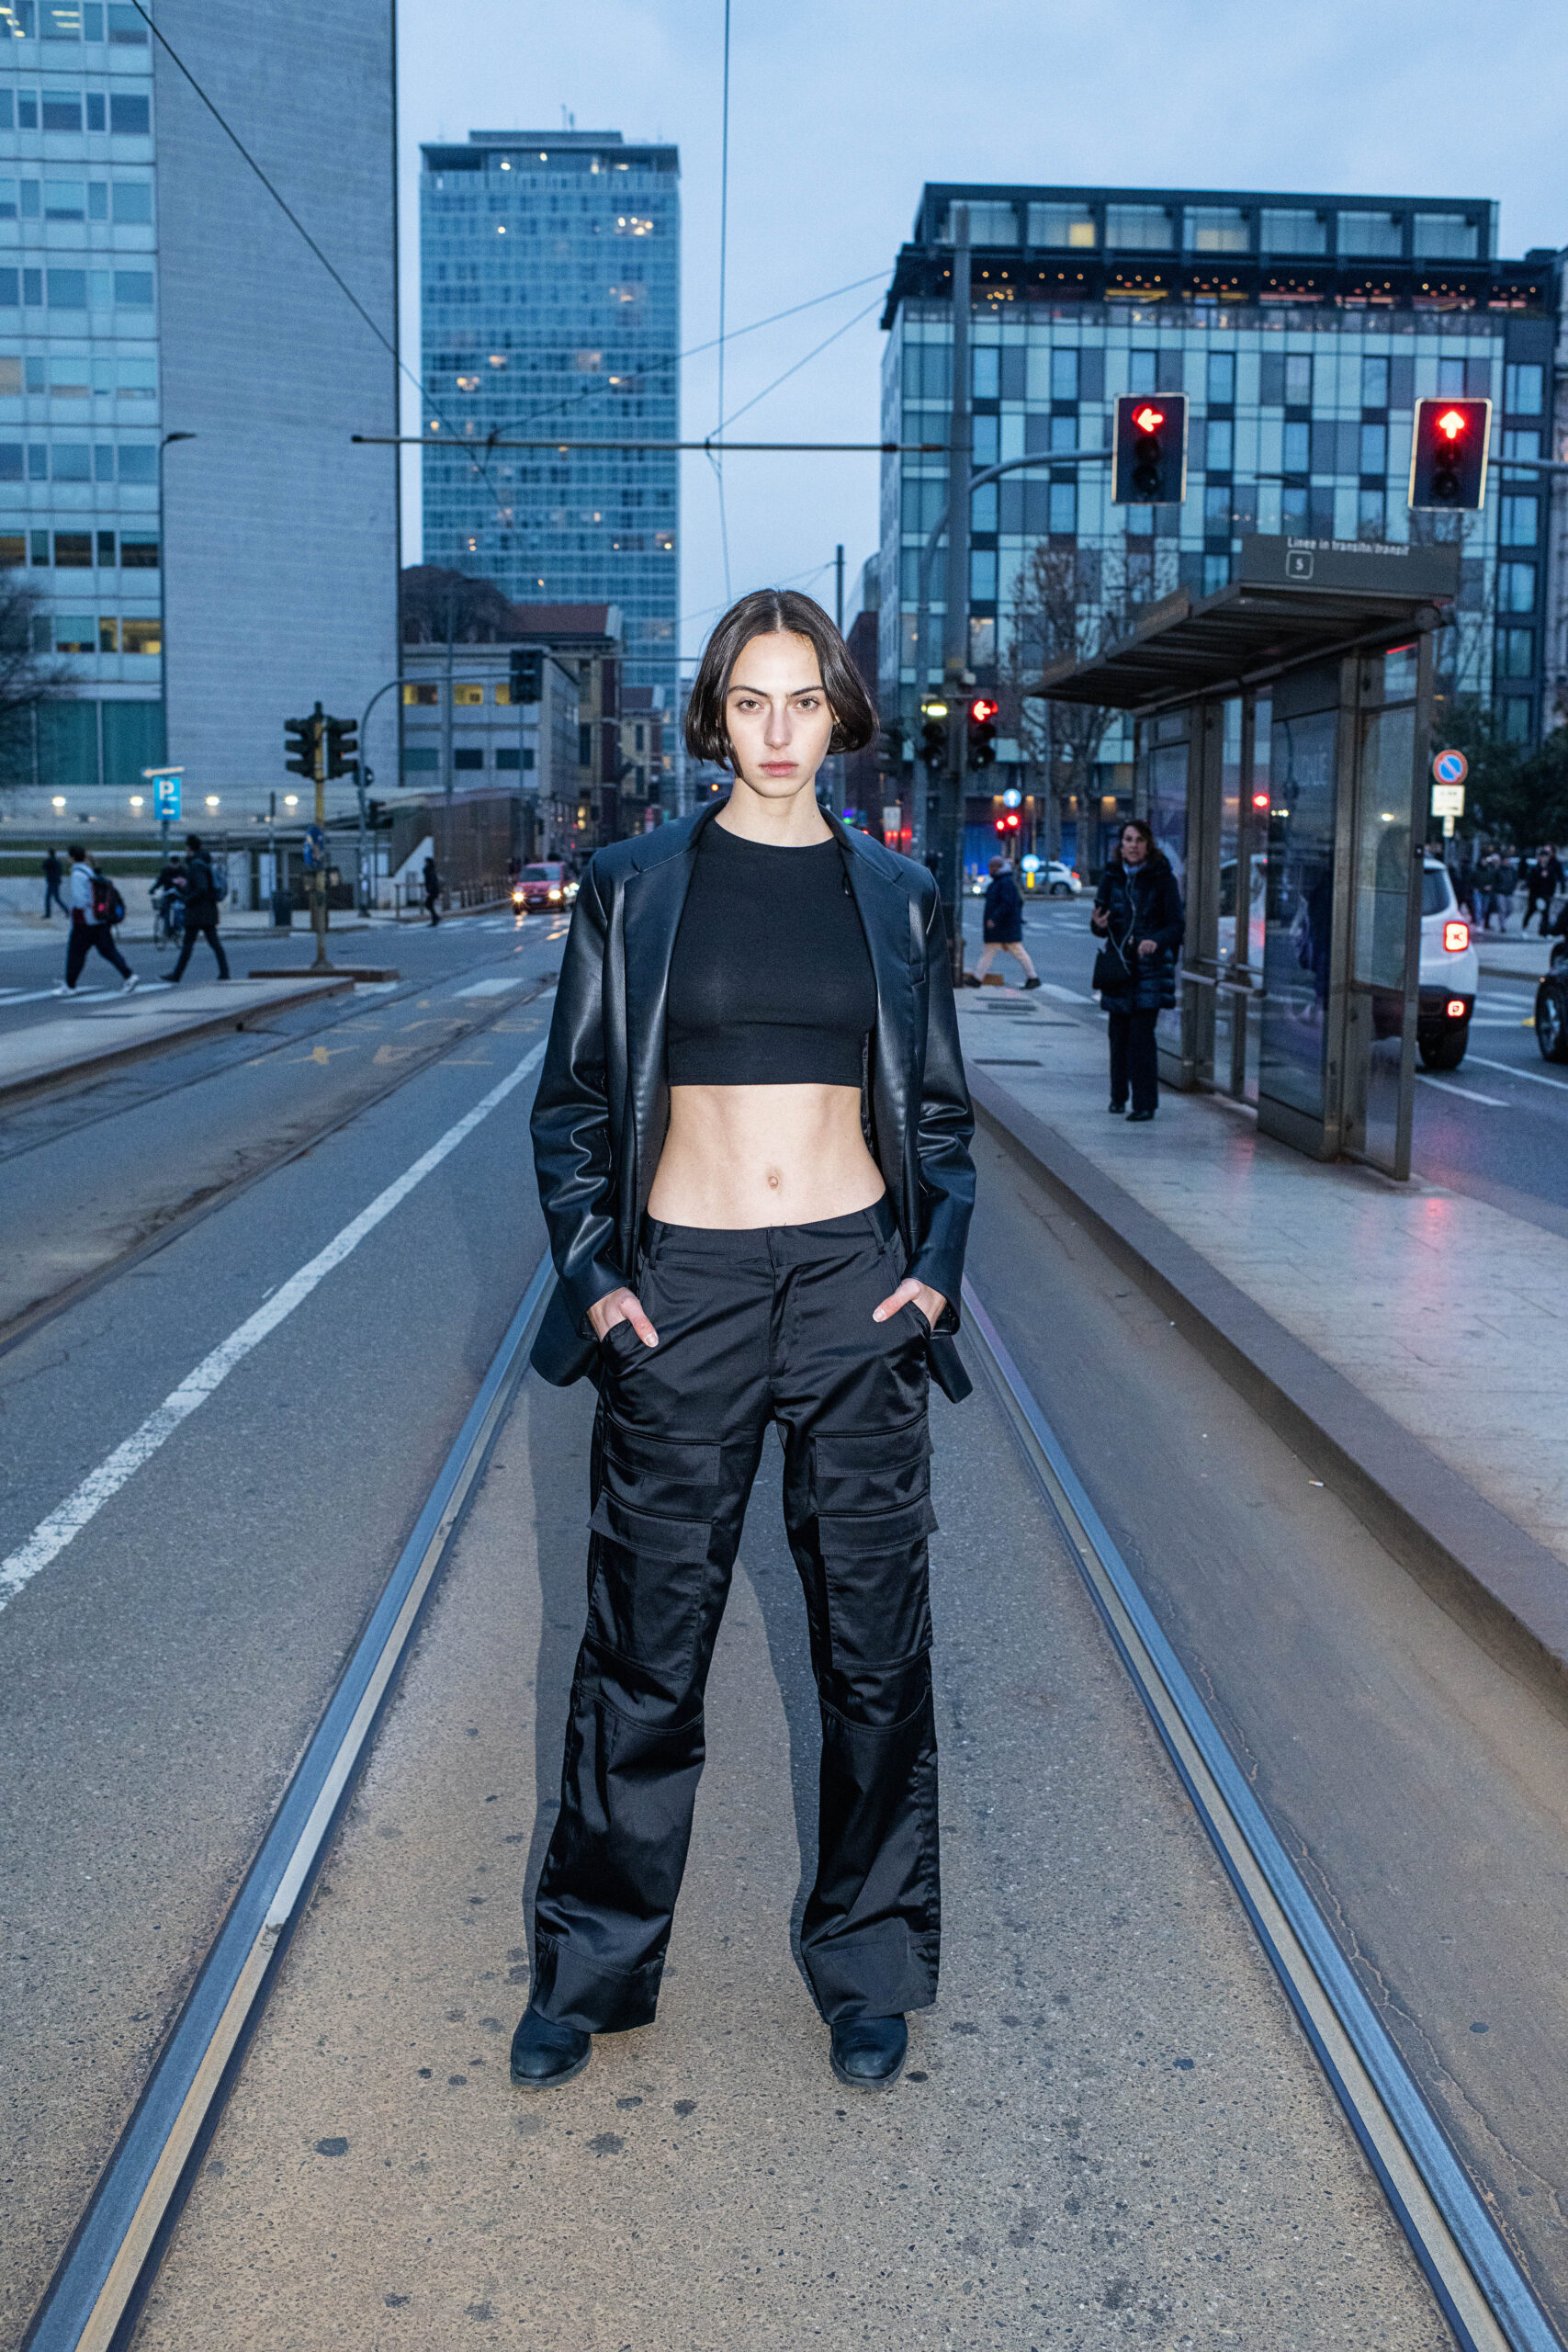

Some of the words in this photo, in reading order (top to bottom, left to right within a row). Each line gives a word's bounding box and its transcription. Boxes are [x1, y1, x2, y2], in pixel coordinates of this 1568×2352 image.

[1287, 537, 1317, 549] Linee
[1319, 538, 1330, 550] in
[159, 780, 175, 800] P
